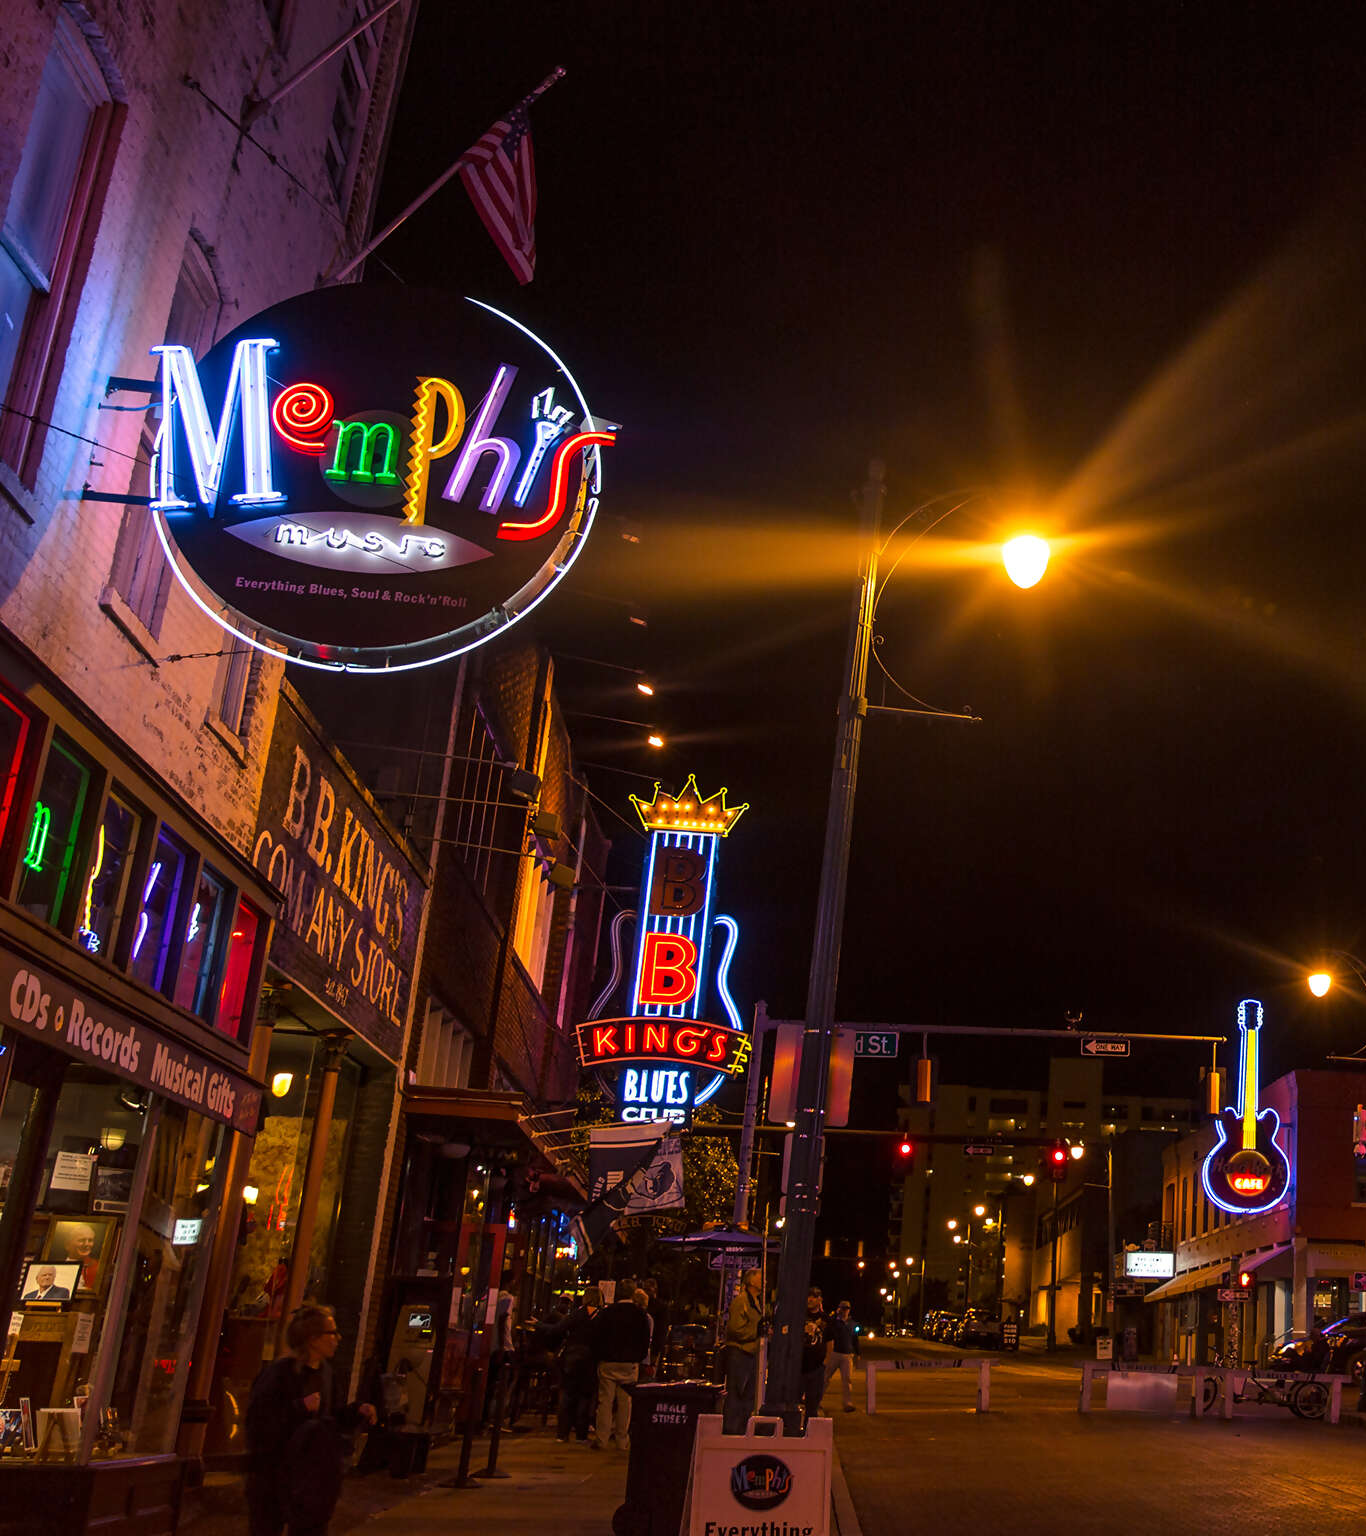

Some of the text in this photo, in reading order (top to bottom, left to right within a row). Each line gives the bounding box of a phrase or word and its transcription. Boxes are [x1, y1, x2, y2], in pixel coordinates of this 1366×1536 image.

[150, 337, 616, 539] Memphis
[235, 577, 305, 594] Everything
[309, 584, 347, 599] Blues,
[351, 588, 379, 600] Soul
[382, 590, 392, 601] &
[649, 846, 707, 917] B
[351, 927, 402, 1027] STORE
[639, 932, 698, 1006] B
[9, 969, 51, 1031] CDs
[66, 998, 141, 1074] Records
[150, 1042, 208, 1105] Musical
[207, 1071, 236, 1120] Gifts
[593, 1024, 729, 1063] KING'S
[867, 1035, 890, 1054] St.
[1095, 1043, 1124, 1052] ONE WAY
[624, 1068, 690, 1104] BLUES
[1234, 1178, 1264, 1189] CAFE
[652, 1414, 689, 1425] STREET
[656, 1403, 688, 1414] BEALE
[731, 1464, 794, 1494] Memphis
